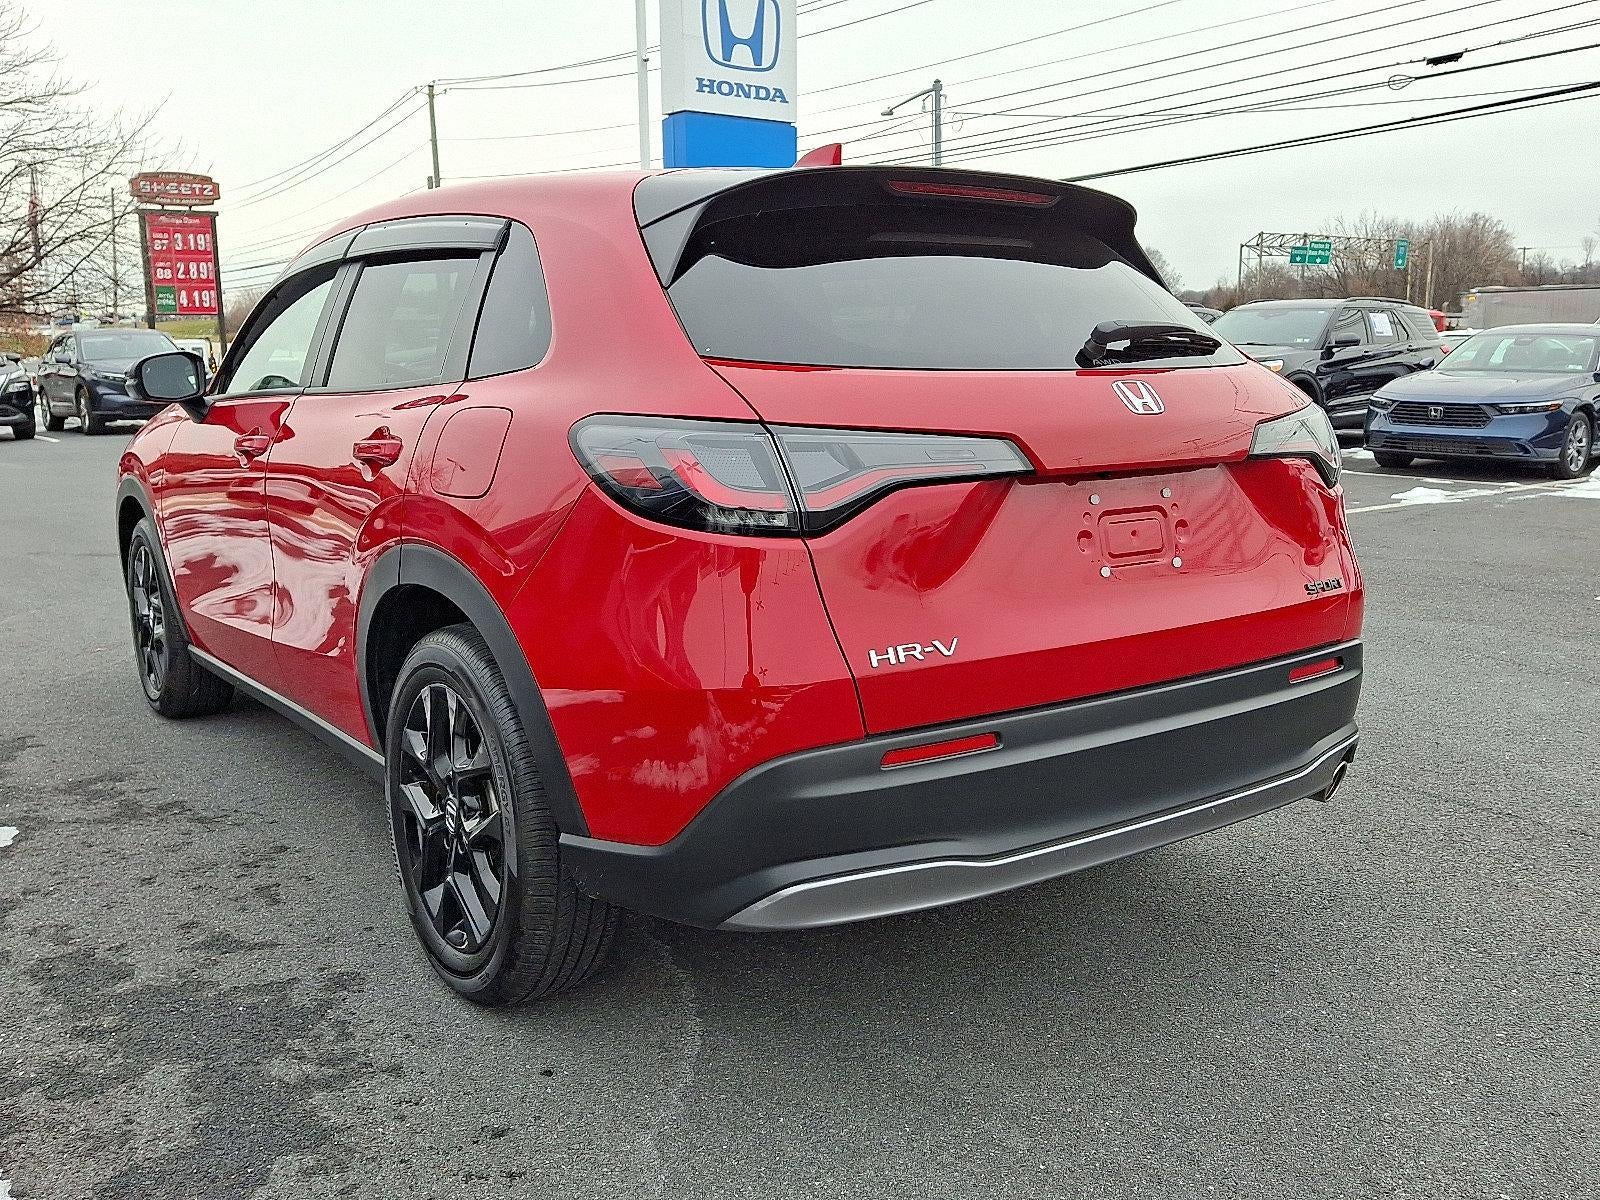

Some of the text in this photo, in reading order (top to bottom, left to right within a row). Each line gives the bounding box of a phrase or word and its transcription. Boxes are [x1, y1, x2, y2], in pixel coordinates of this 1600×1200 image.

[695, 77, 789, 104] HONDA
[140, 180, 214, 196] SHEETZ
[153, 239, 168, 251] 87
[156, 268, 173, 280] 88
[1304, 578, 1343, 595] SPORT
[868, 636, 959, 668] HR-V
